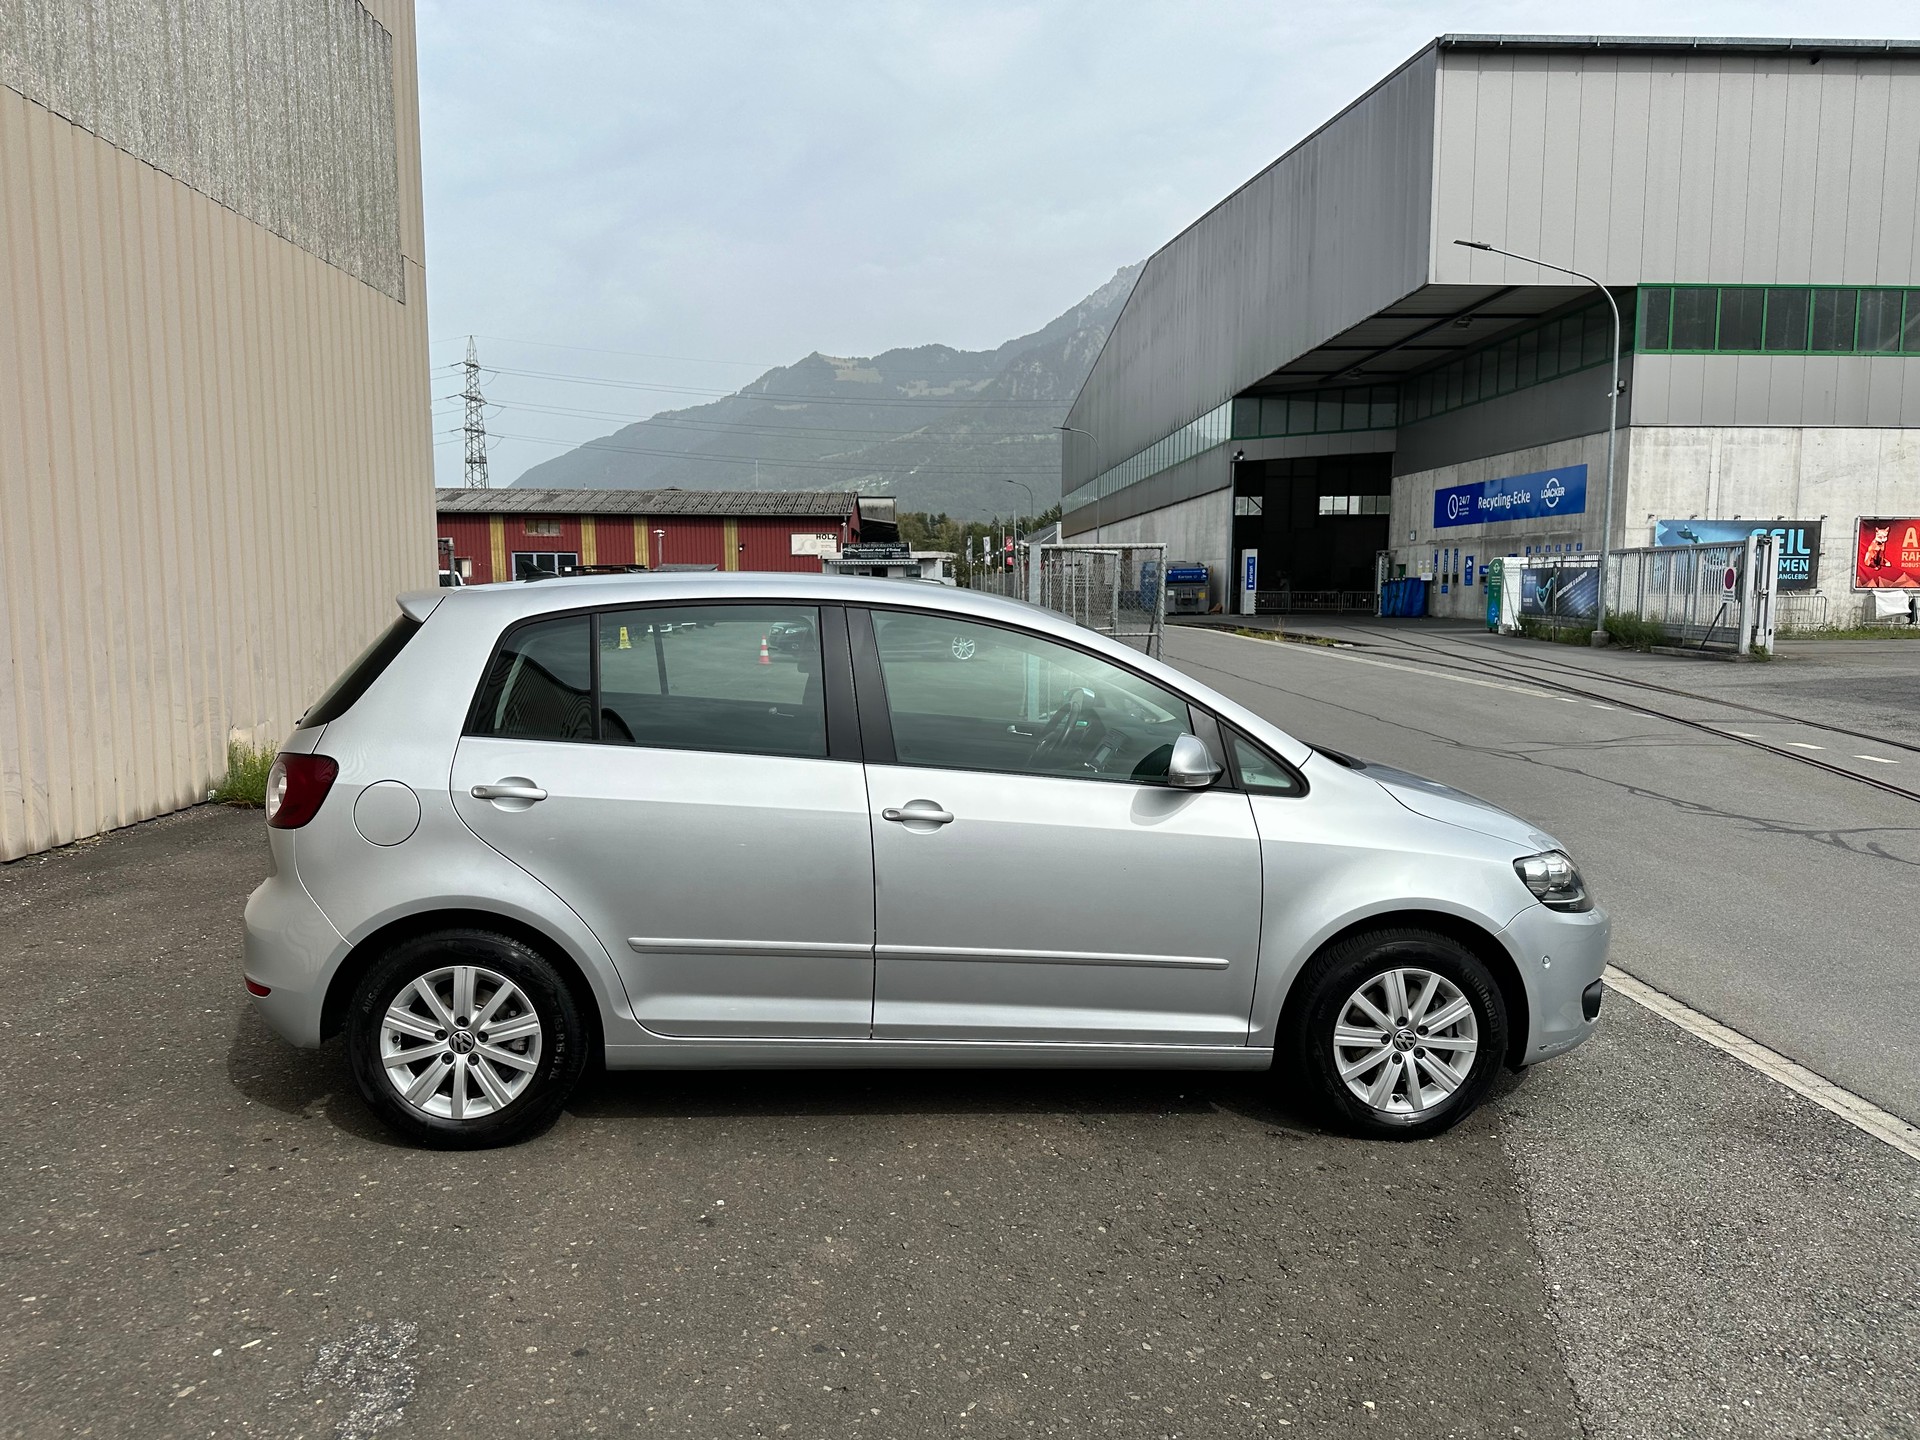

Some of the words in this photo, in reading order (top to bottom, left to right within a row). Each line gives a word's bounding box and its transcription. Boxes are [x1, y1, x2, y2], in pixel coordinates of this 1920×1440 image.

[1541, 486, 1565, 499] LOACKER
[1459, 495, 1470, 505] 24/7
[1478, 489, 1531, 511] Recycling-Ecke
[1751, 528, 1810, 555] EIL
[1779, 559, 1809, 572] MEN
